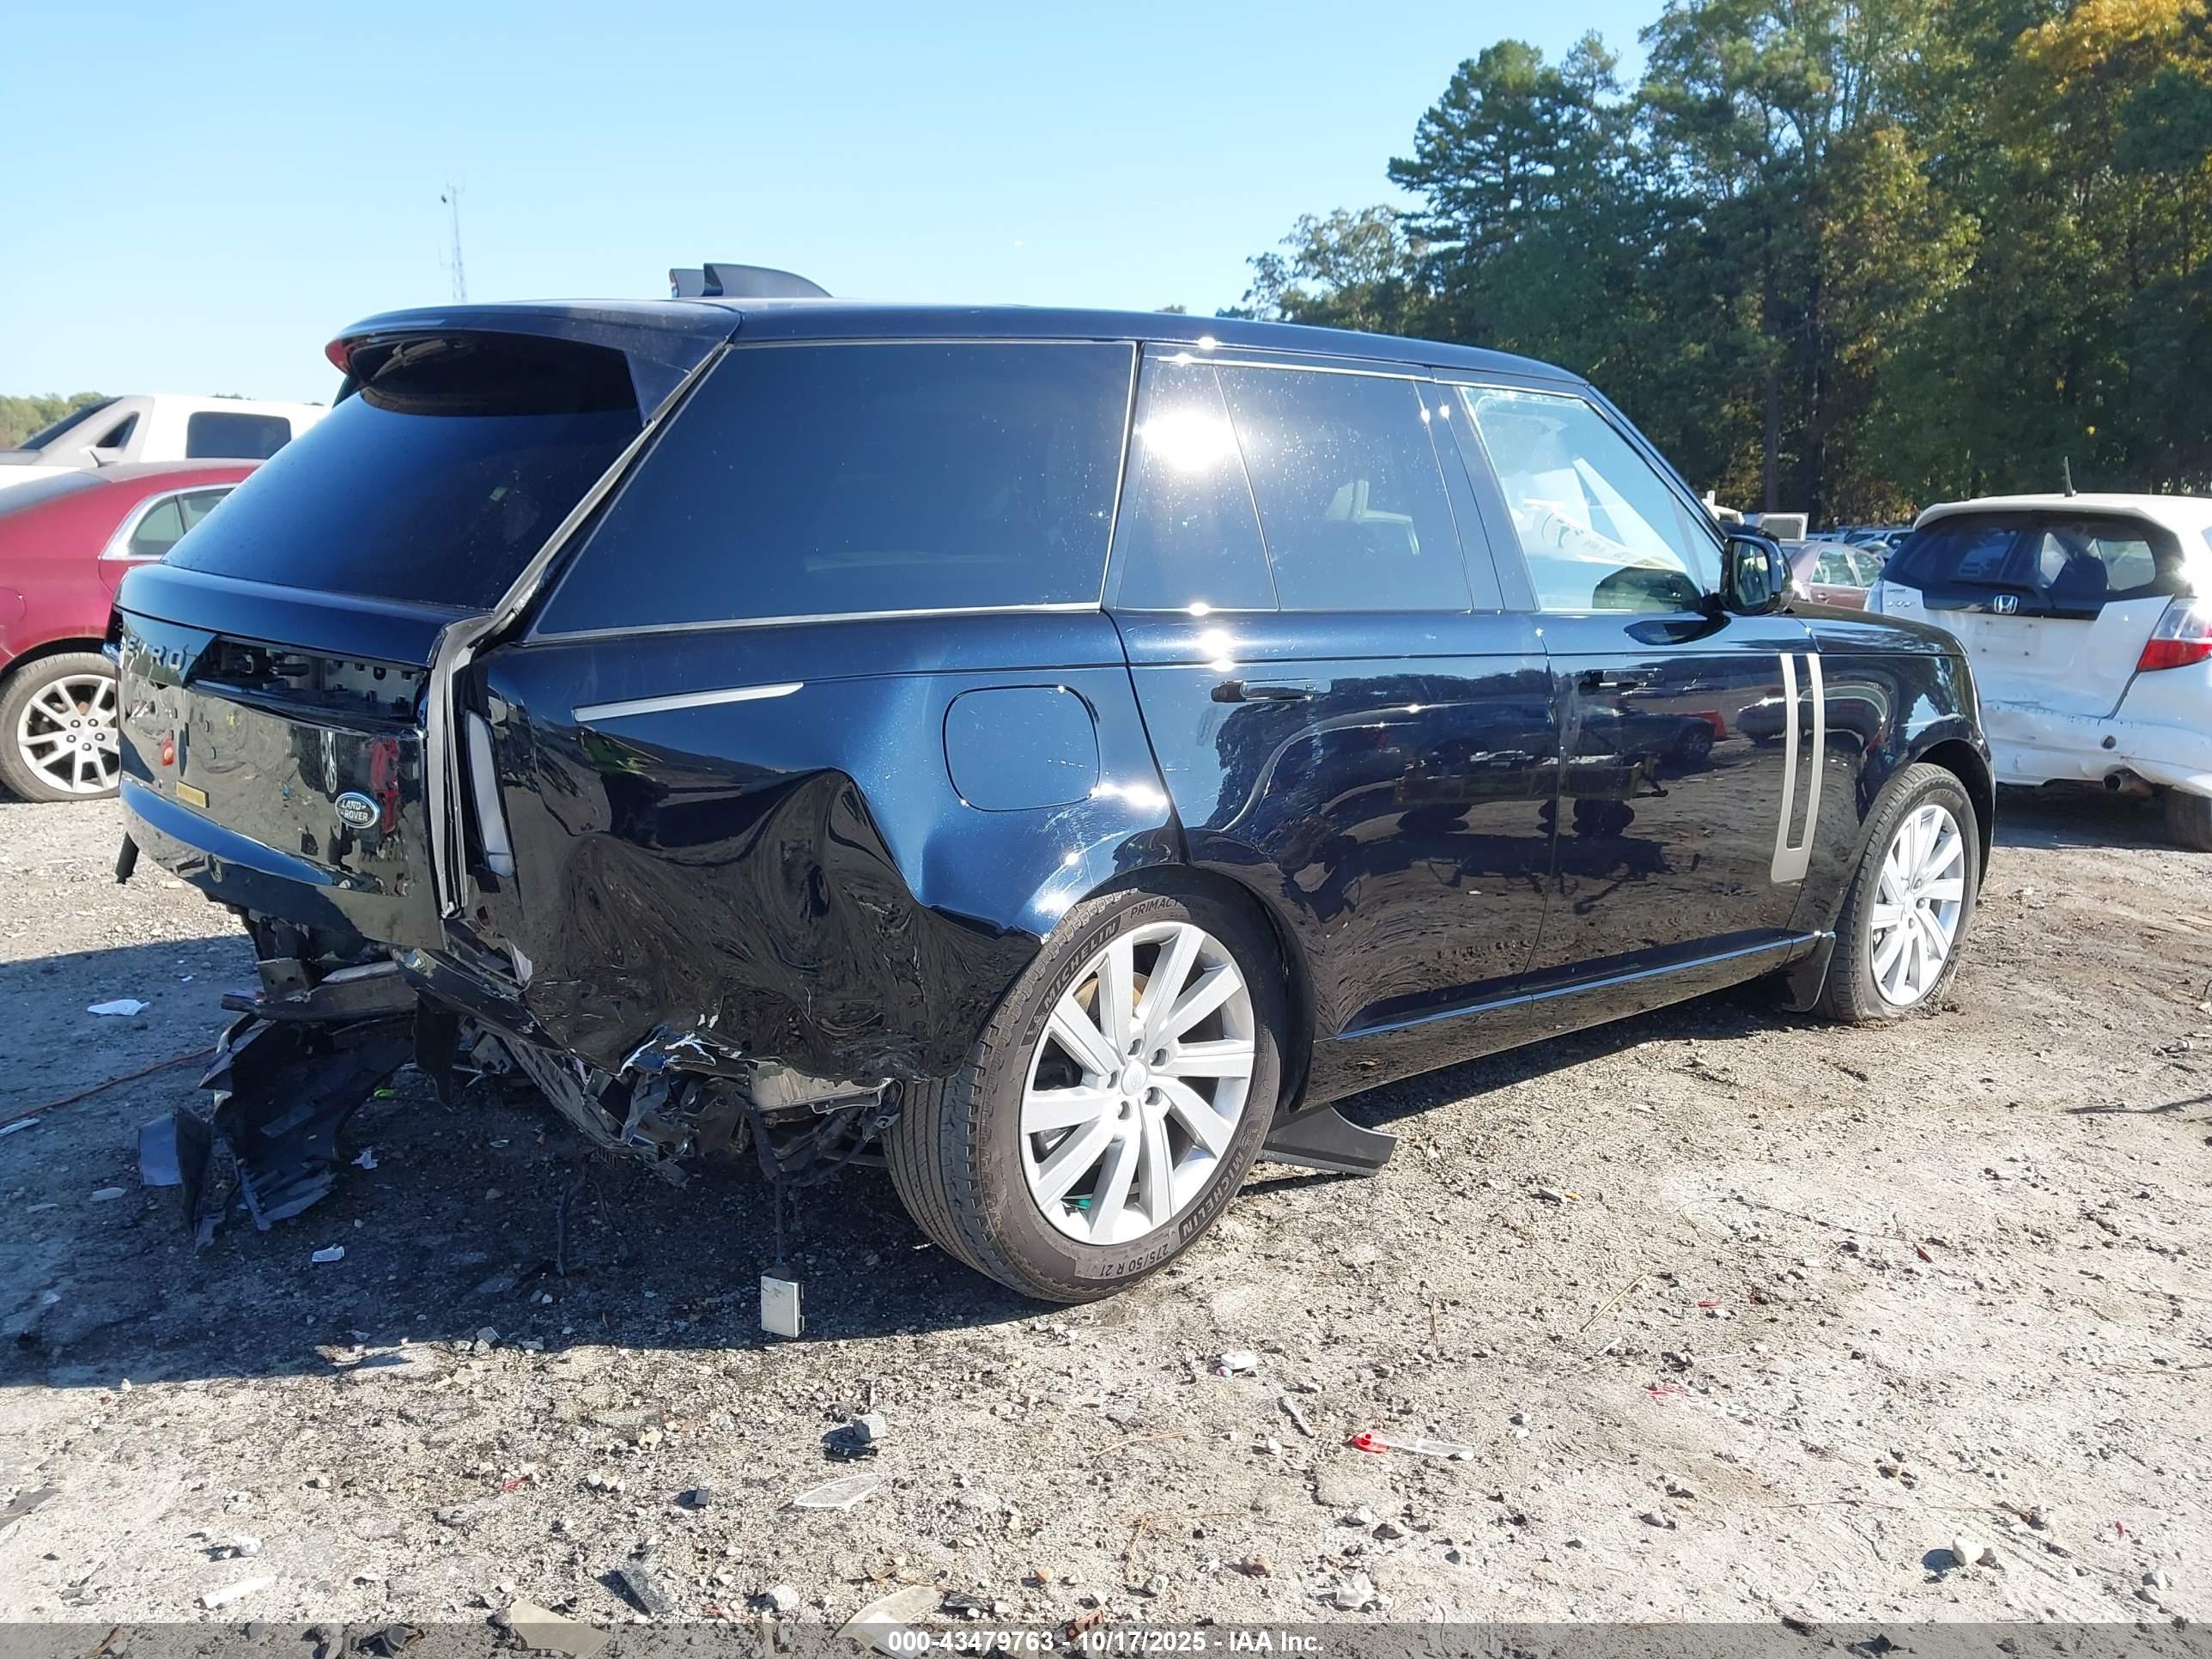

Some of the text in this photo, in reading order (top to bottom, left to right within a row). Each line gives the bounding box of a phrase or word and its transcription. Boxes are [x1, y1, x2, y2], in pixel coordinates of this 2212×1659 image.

[342, 799, 362, 811] LAND
[344, 810, 368, 822] ROVER
[1043, 921, 1116, 1009] MICHELIN
[1182, 1150, 1244, 1237] MICHELIN
[1100, 1243, 1169, 1277] 275/50 R 21
